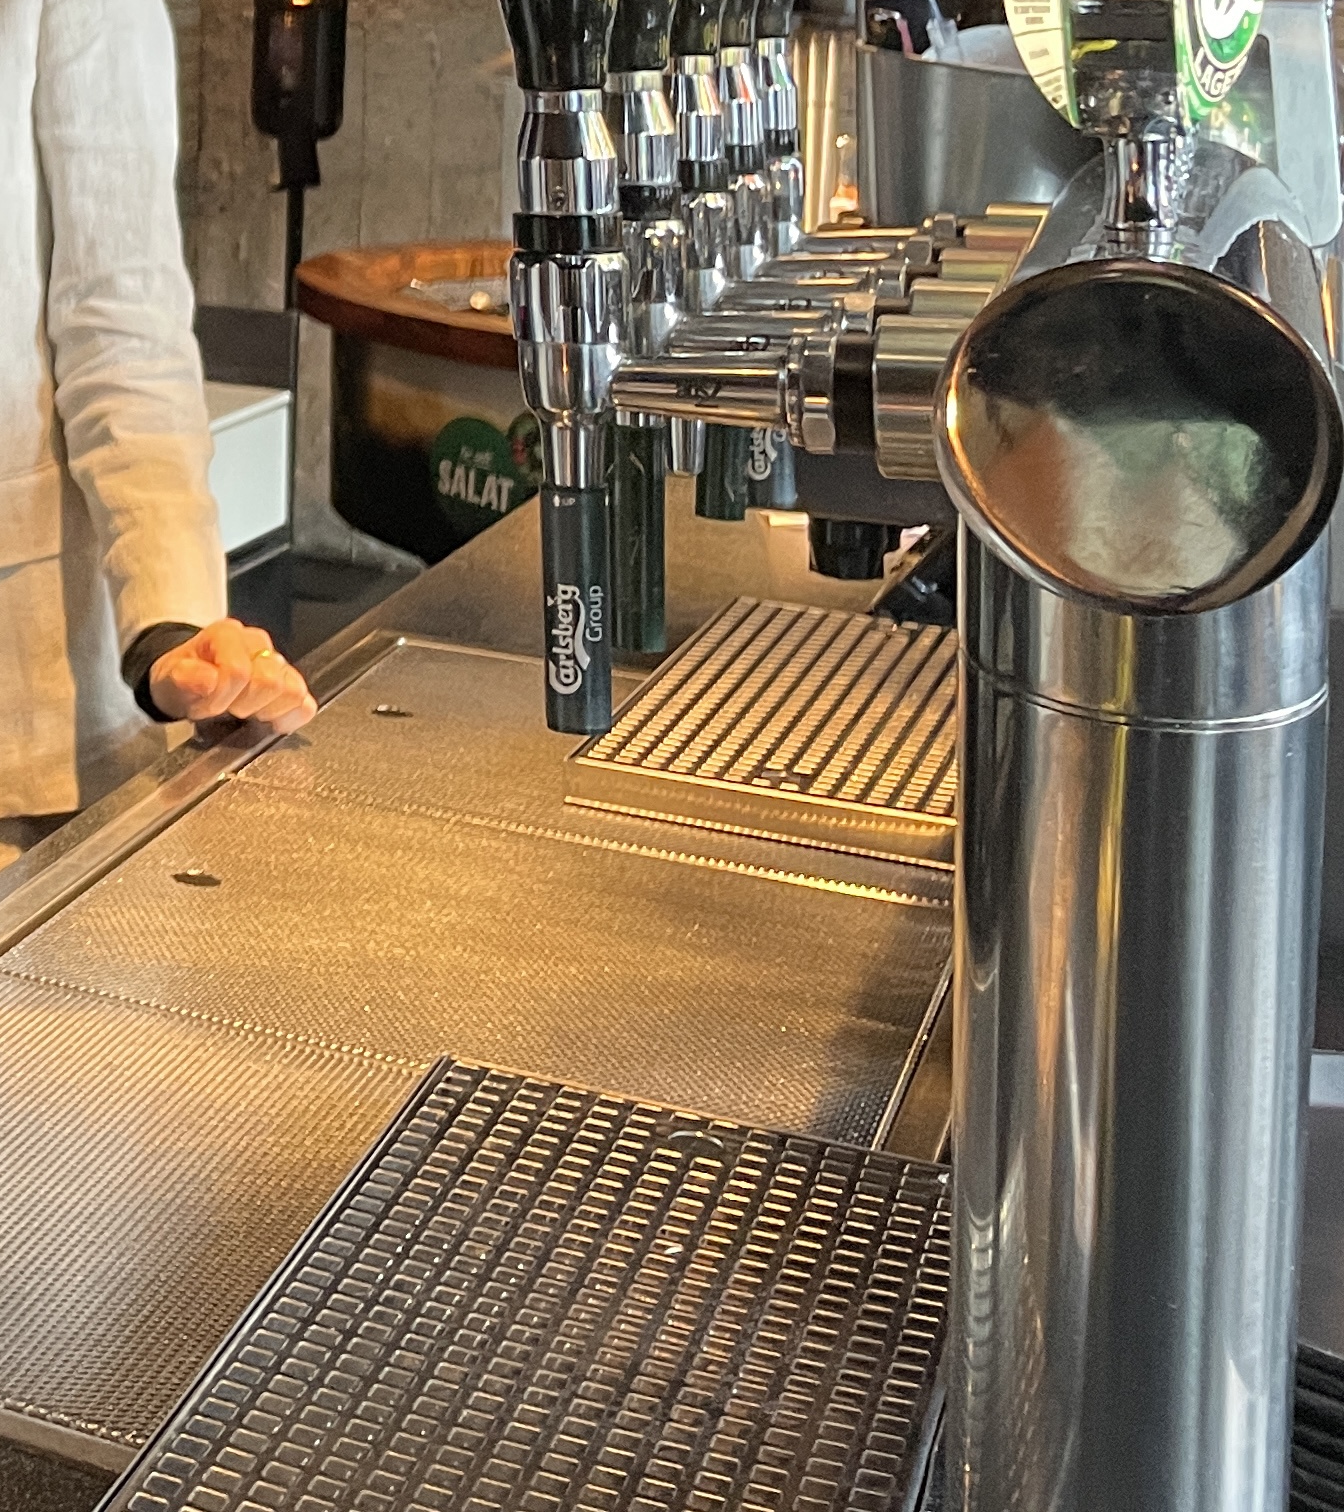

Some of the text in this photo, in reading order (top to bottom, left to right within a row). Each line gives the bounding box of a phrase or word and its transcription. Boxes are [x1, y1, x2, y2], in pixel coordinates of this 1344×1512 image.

[437, 459, 514, 513] SALAT
[548, 584, 586, 694] Carlsberg
[585, 585, 604, 642] Group
